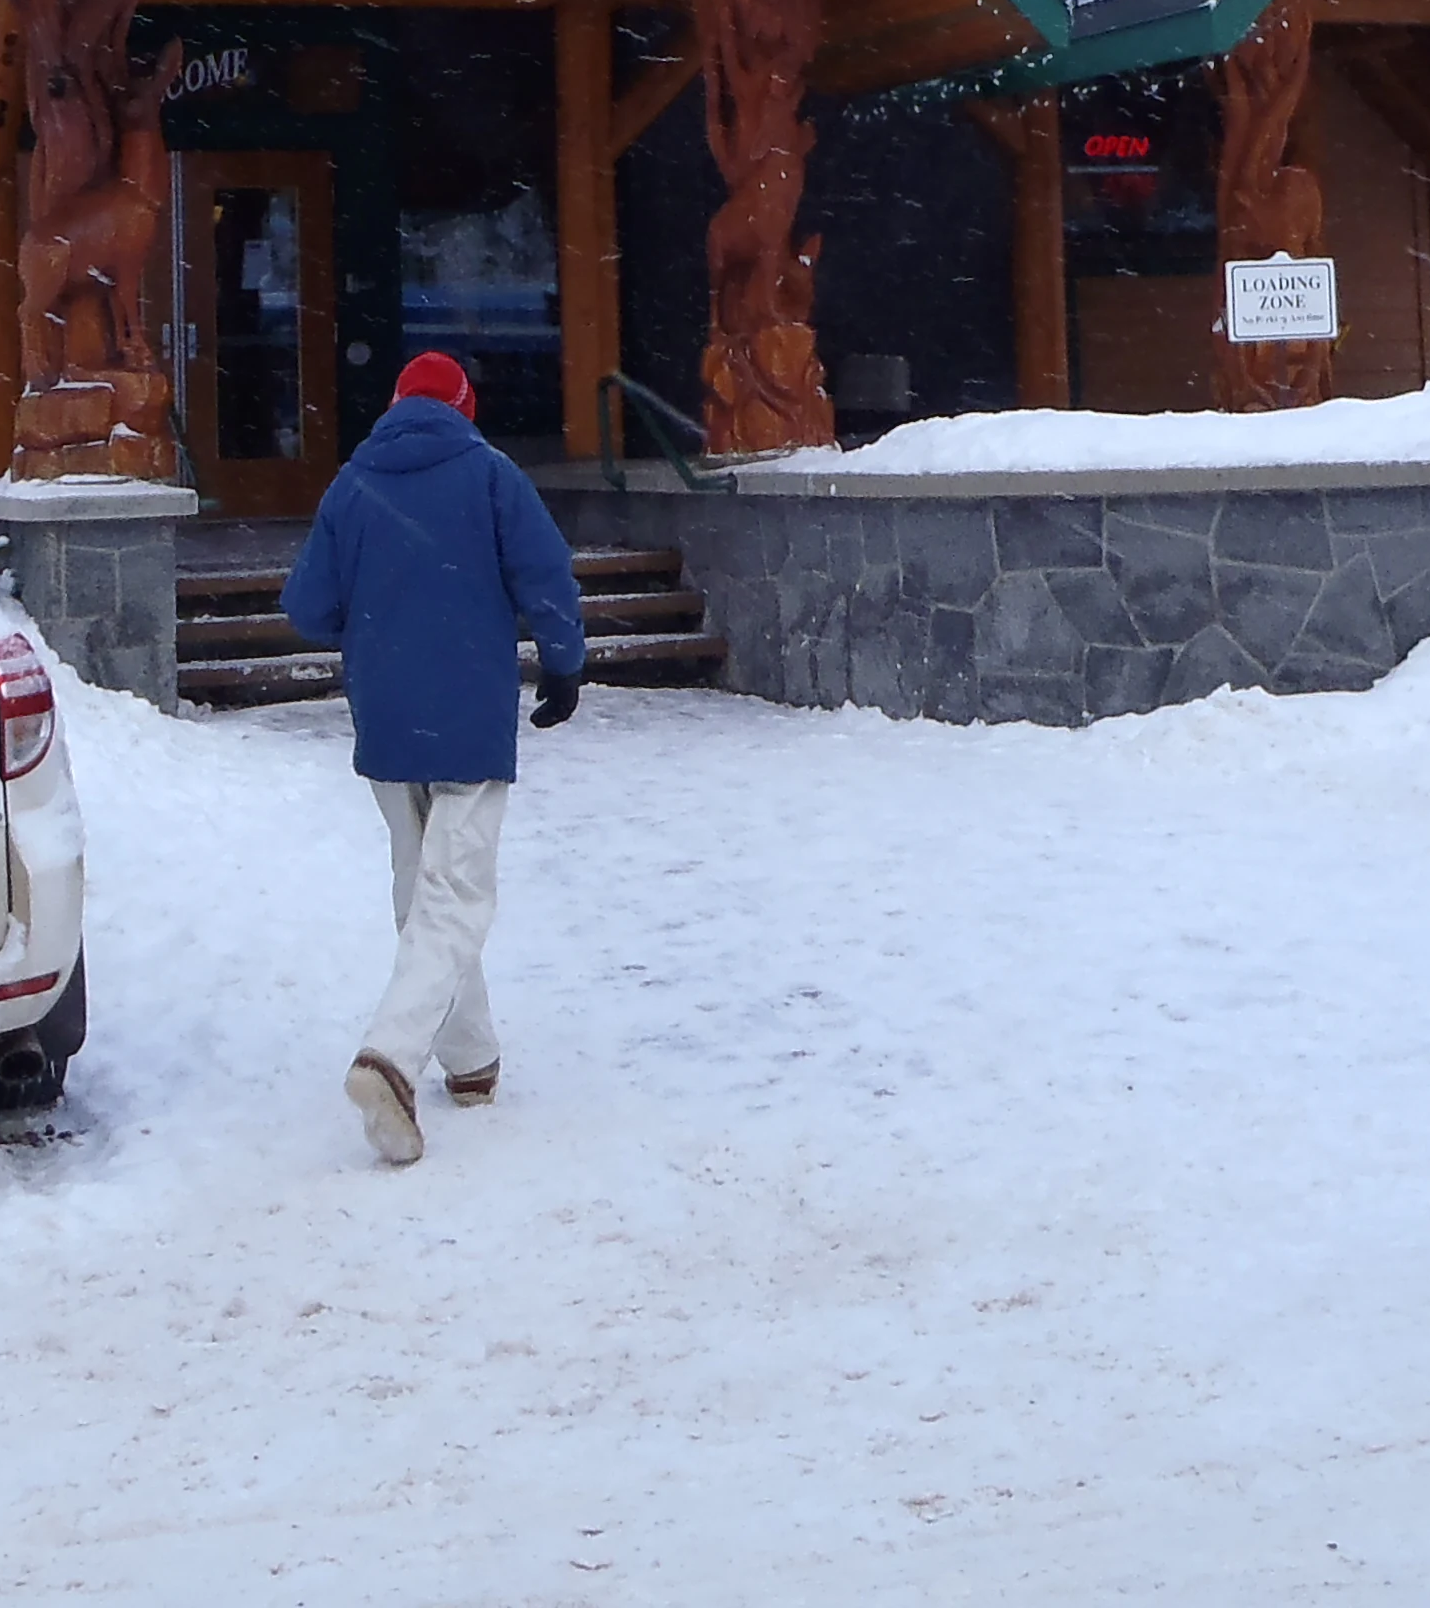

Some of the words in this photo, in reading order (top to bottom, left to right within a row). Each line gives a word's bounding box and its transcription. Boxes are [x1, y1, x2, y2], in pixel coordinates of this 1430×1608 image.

[160, 47, 249, 104] COME
[1083, 135, 1151, 158] OPEN
[1241, 275, 1322, 294] LOADING
[1259, 294, 1307, 311] ZONE
